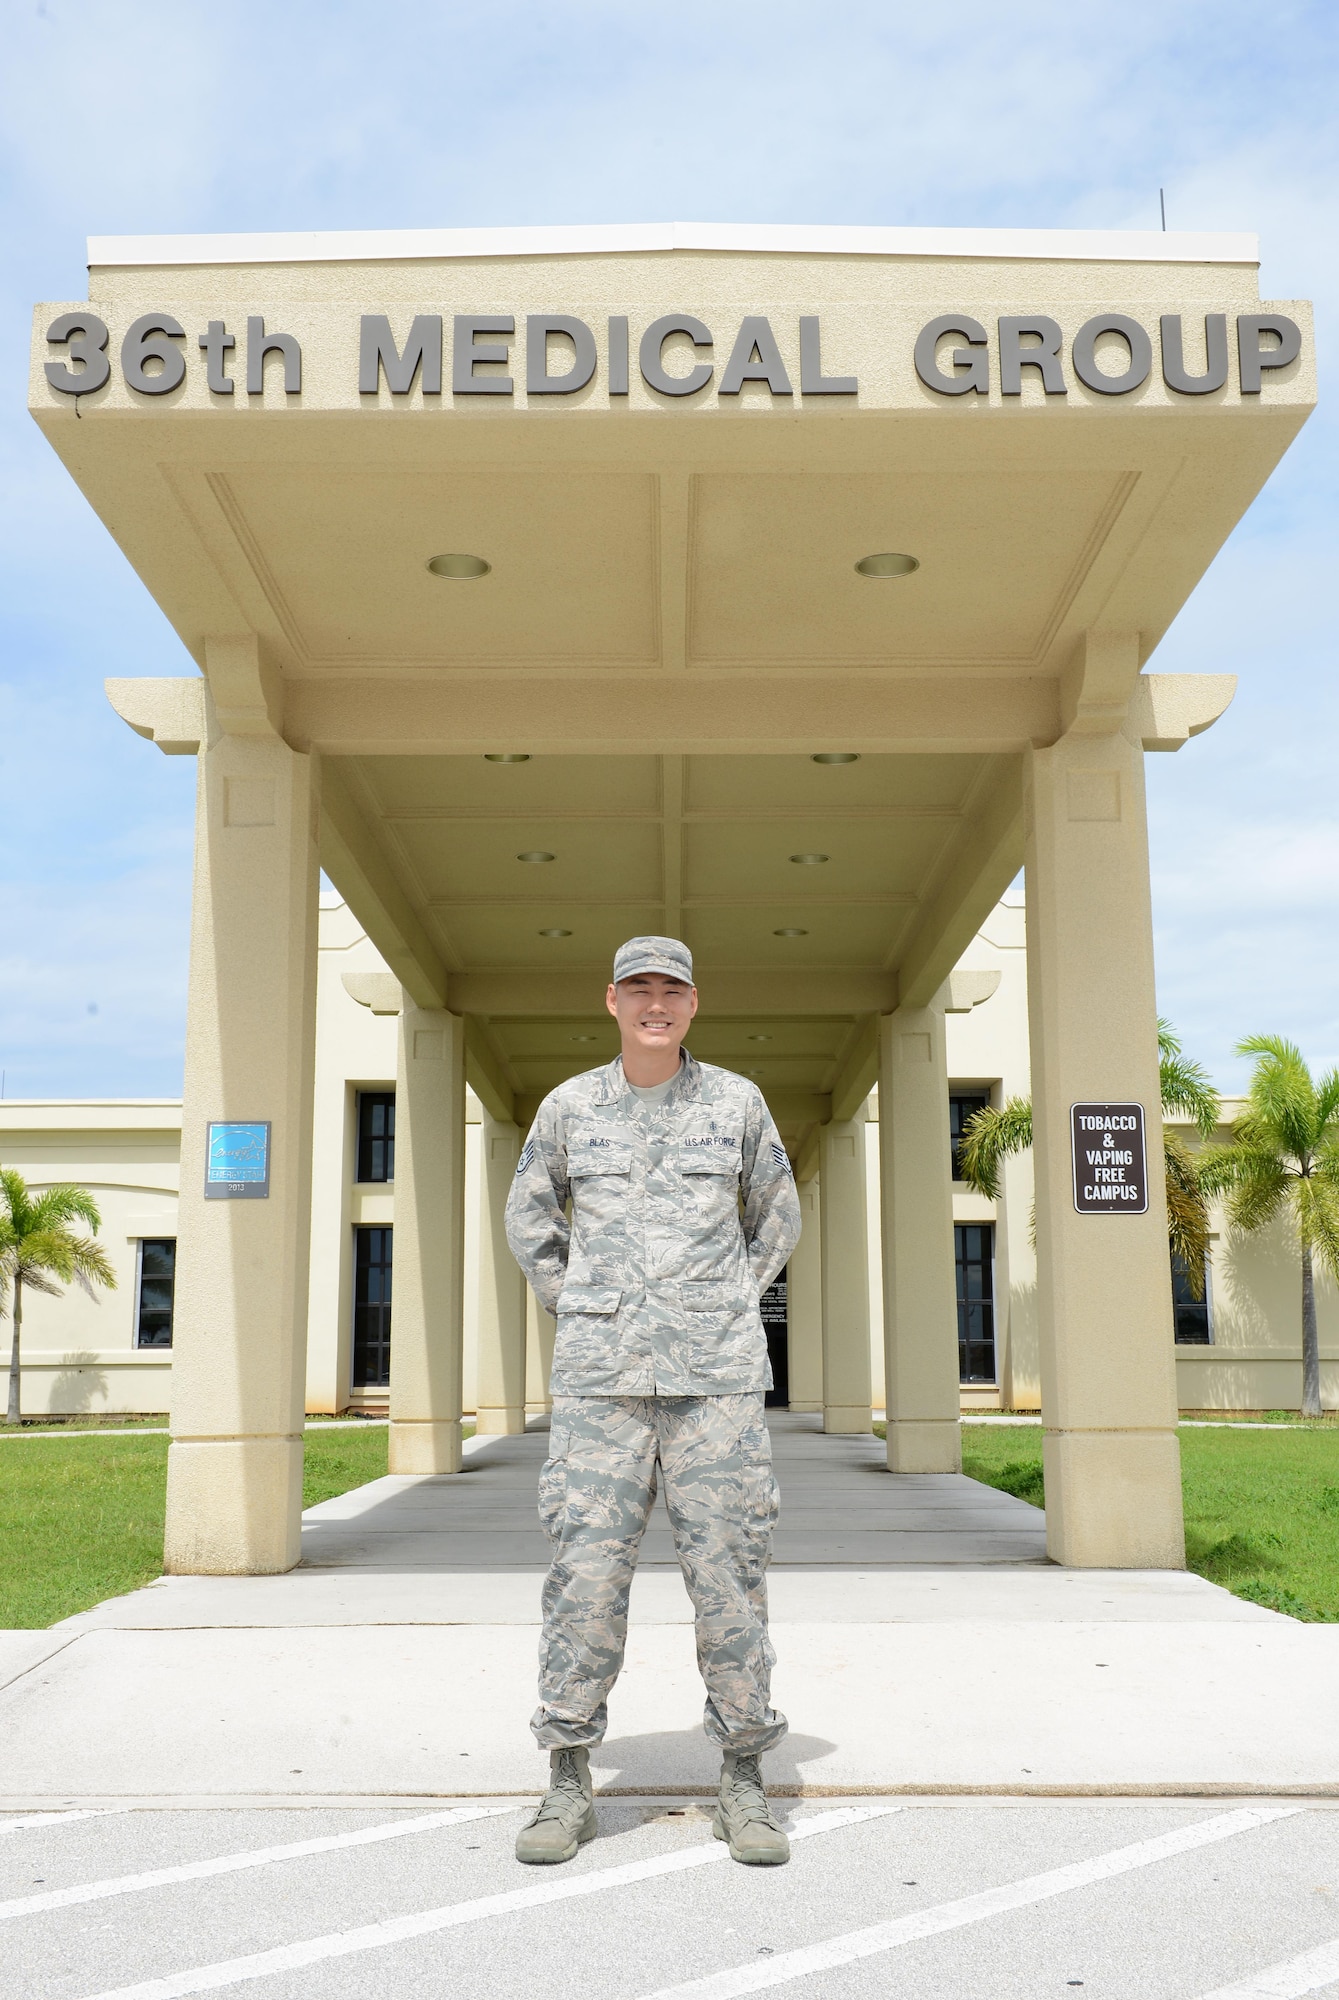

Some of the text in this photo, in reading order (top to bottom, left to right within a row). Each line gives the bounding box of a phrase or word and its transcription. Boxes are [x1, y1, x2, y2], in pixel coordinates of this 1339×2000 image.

[44, 312, 1302, 396] 36th MEDICAL GROUP
[1079, 1115, 1137, 1131] TOBACCO
[589, 1138, 610, 1147] BLAS
[700, 1137, 714, 1146] AIR
[714, 1136, 736, 1147] FORCE
[1102, 1132, 1115, 1148] &
[1085, 1150, 1133, 1165] VAPING
[211, 1170, 241, 1179] ENERGY
[1094, 1167, 1126, 1183] FREE
[228, 1183, 245, 1192] 2013
[1083, 1185, 1138, 1201] CAMPUS
